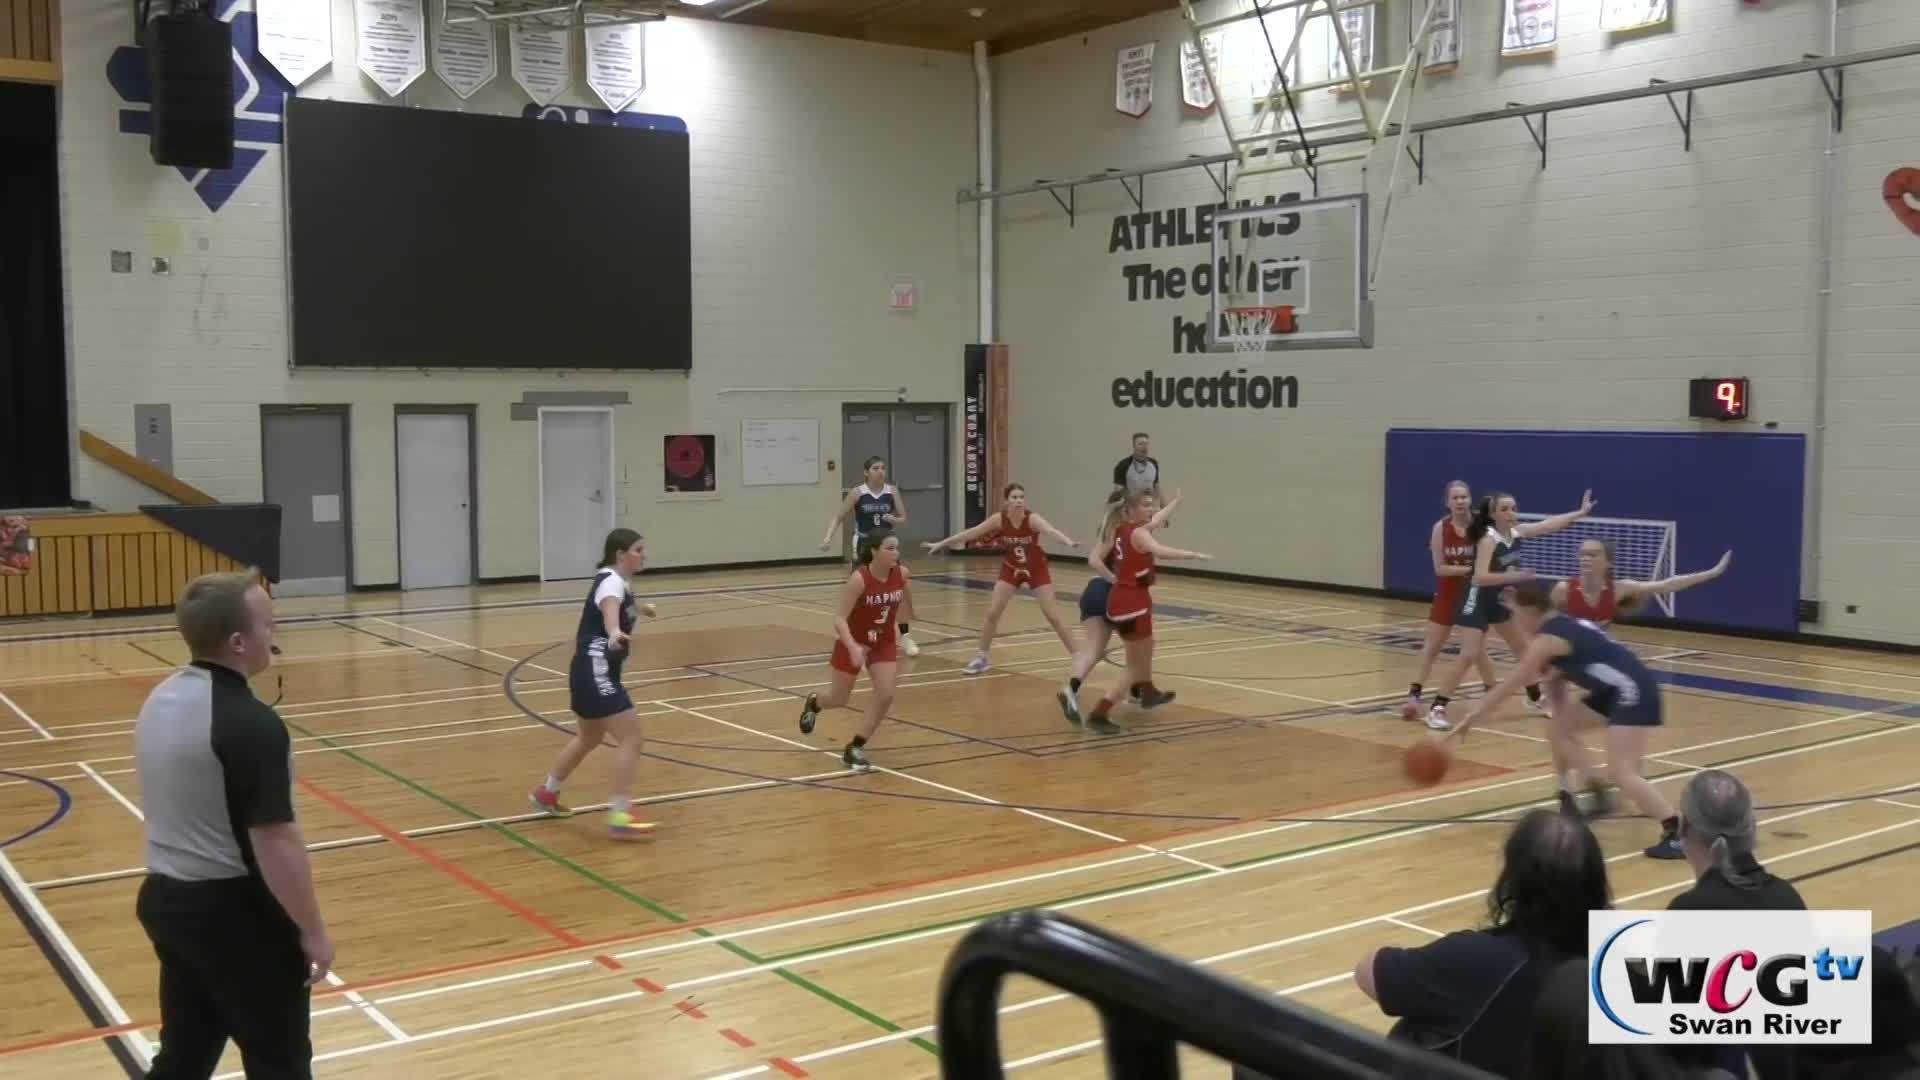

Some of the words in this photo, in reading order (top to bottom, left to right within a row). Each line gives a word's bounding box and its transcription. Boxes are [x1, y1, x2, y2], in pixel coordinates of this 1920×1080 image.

[1123, 263, 1186, 301] The
[1111, 369, 1298, 408] education
[873, 605, 891, 624] 3
